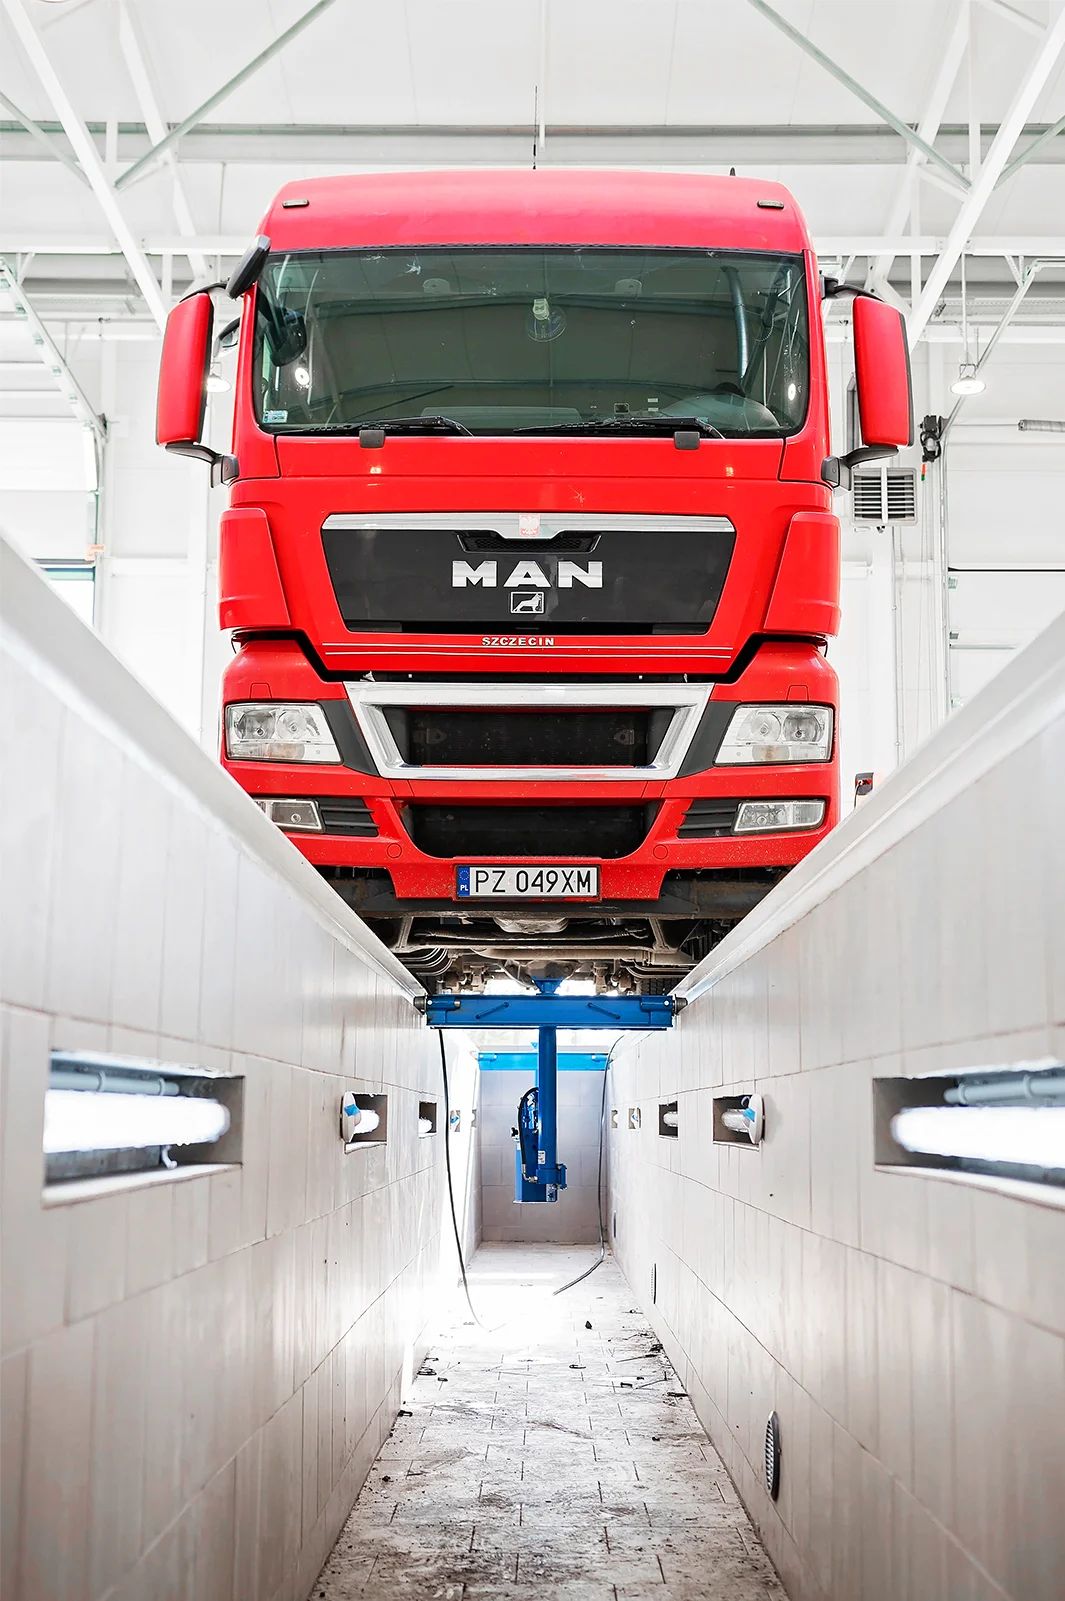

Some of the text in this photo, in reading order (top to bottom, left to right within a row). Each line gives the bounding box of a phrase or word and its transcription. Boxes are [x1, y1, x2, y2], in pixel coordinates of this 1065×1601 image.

[452, 560, 603, 588] MAN
[482, 636, 555, 647] SZCZECIN
[475, 870, 591, 893] PZ 049XM
